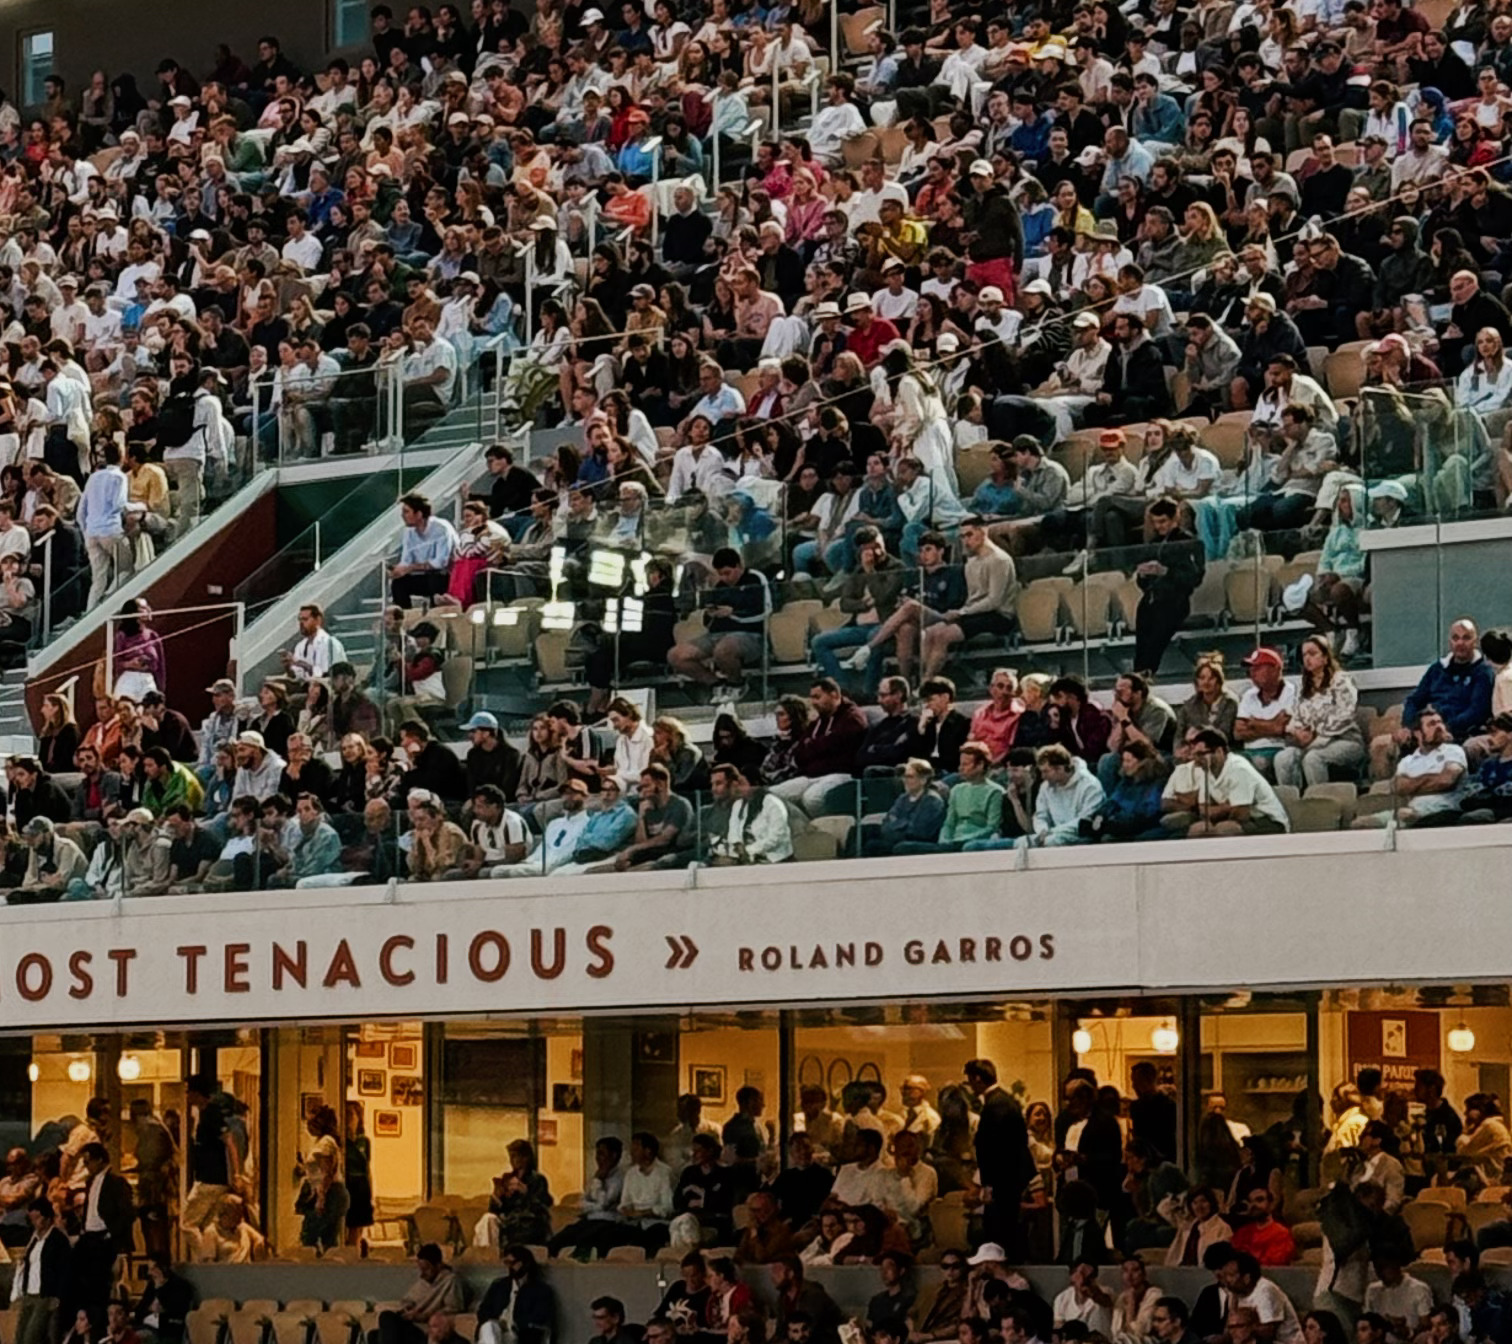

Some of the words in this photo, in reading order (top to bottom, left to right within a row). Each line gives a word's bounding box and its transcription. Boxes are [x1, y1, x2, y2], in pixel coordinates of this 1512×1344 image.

[177, 925, 615, 994] TENACIOUS
[738, 941, 884, 972] ROLAND
[904, 934, 1056, 966] GARROS
